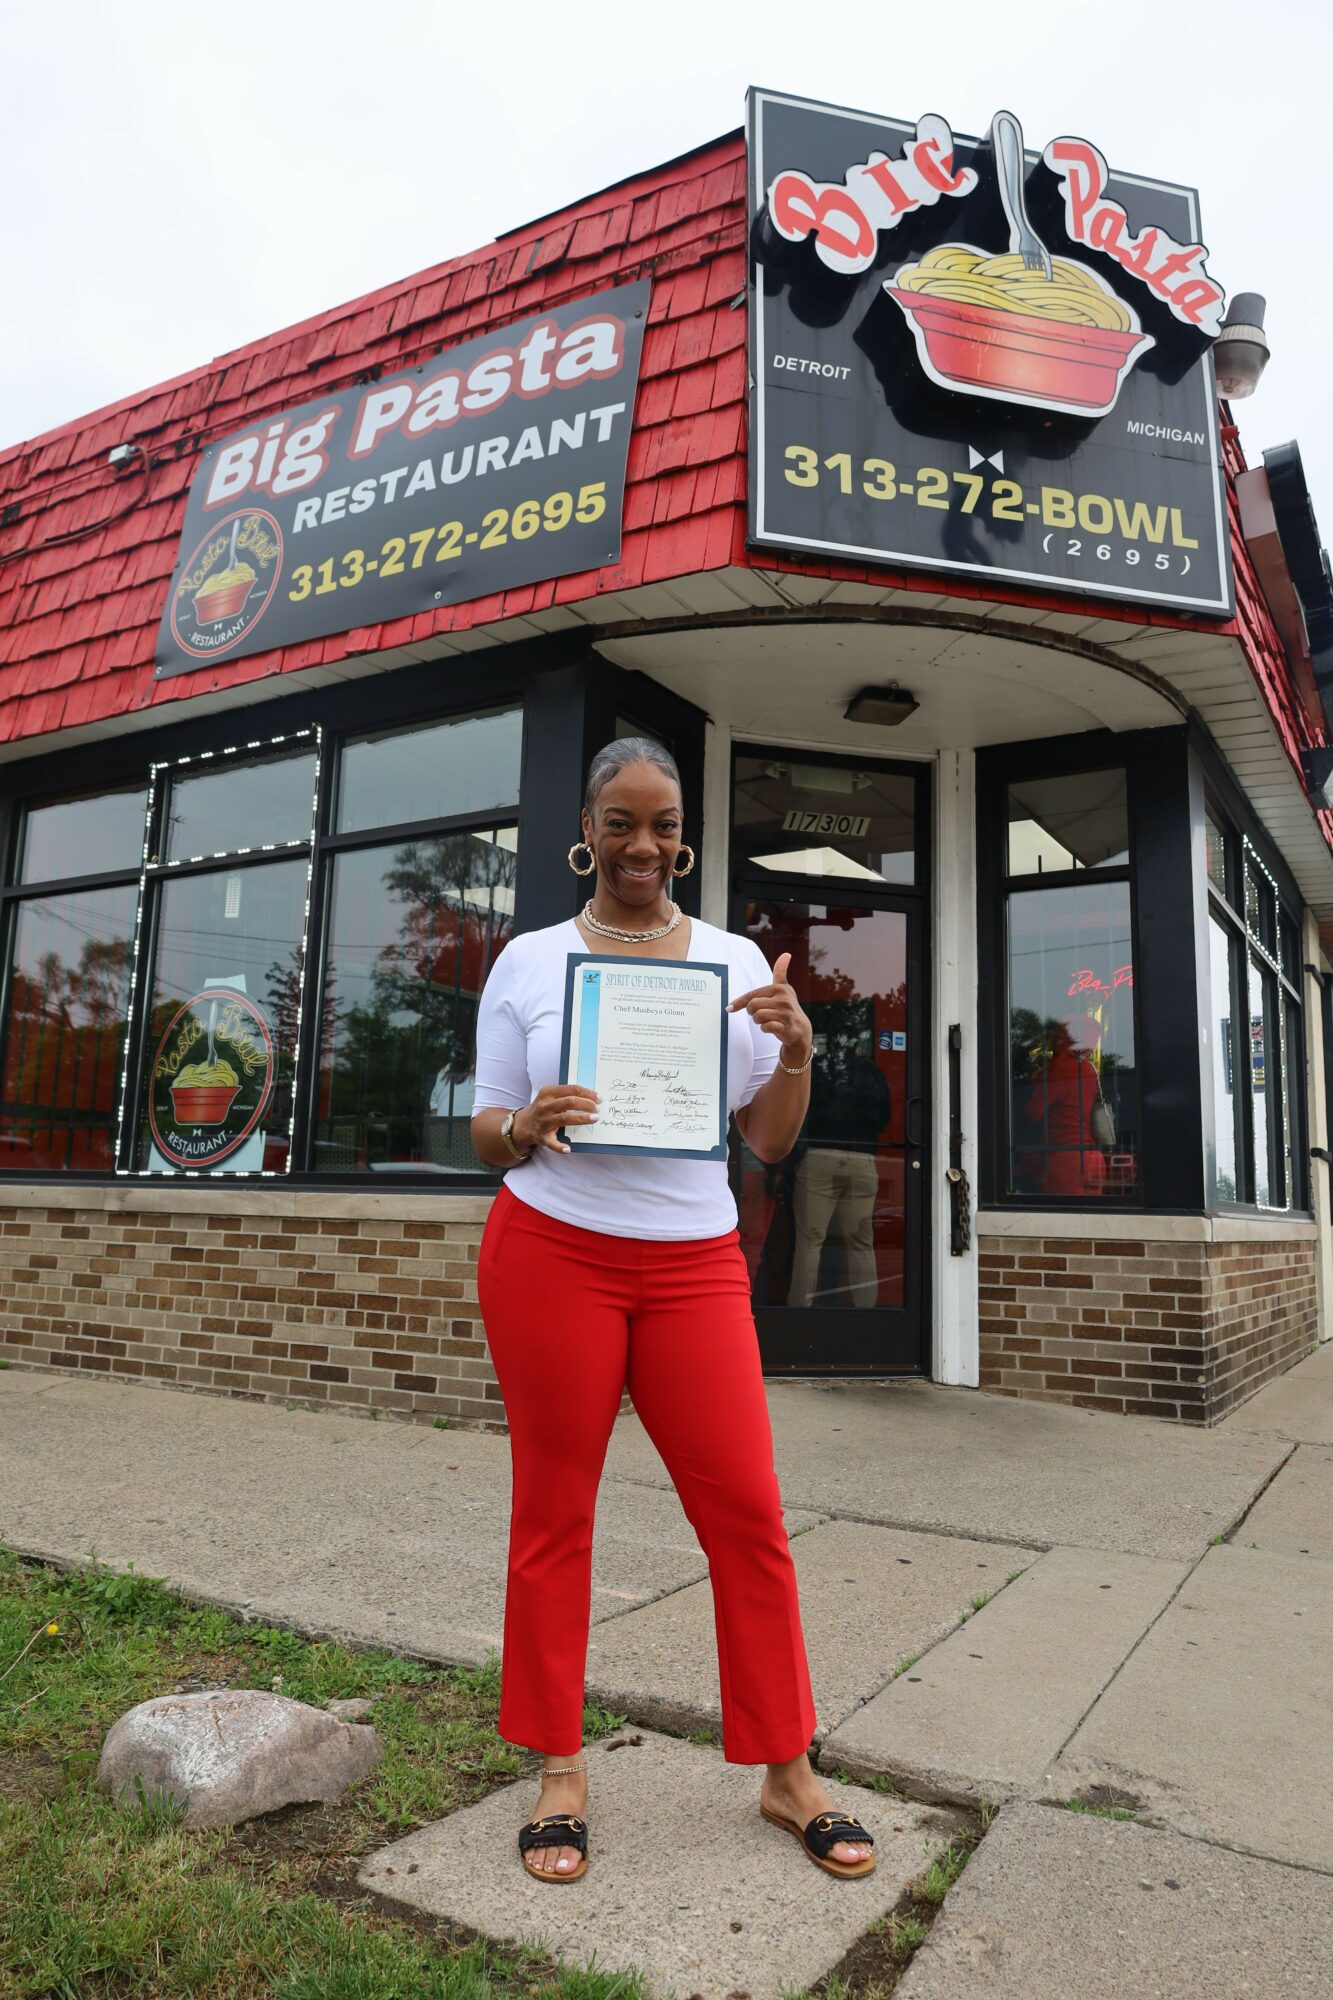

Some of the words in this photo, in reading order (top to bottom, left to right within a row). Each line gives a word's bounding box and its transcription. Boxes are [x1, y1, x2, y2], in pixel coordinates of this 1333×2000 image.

[1052, 142, 1221, 324] Pasta
[772, 354, 852, 381] DETROIT
[206, 411, 336, 505] Big
[353, 321, 620, 454] Pasta
[1126, 420, 1206, 446] MICHIGAN
[292, 402, 626, 534] RESTAURANT
[783, 445, 1200, 550] 313-272-BOWL
[177, 535, 232, 598] Pasta
[236, 514, 282, 568] Bowl
[288, 481, 607, 603] 313-272-2695
[190, 618, 246, 647] RESTAURANT
[788, 812, 865, 835] 17301
[606, 973, 631, 986] SPIRIT
[631, 975, 643, 988] OF
[643, 976, 678, 990] DETROIT
[679, 978, 707, 992] AWARD
[614, 1004, 632, 1013] Chef
[664, 1008, 685, 1016] Glenn
[155, 1015, 207, 1080] Pasta
[215, 1003, 271, 1077] Bowl
[167, 1130, 228, 1154] RESTAURANT
